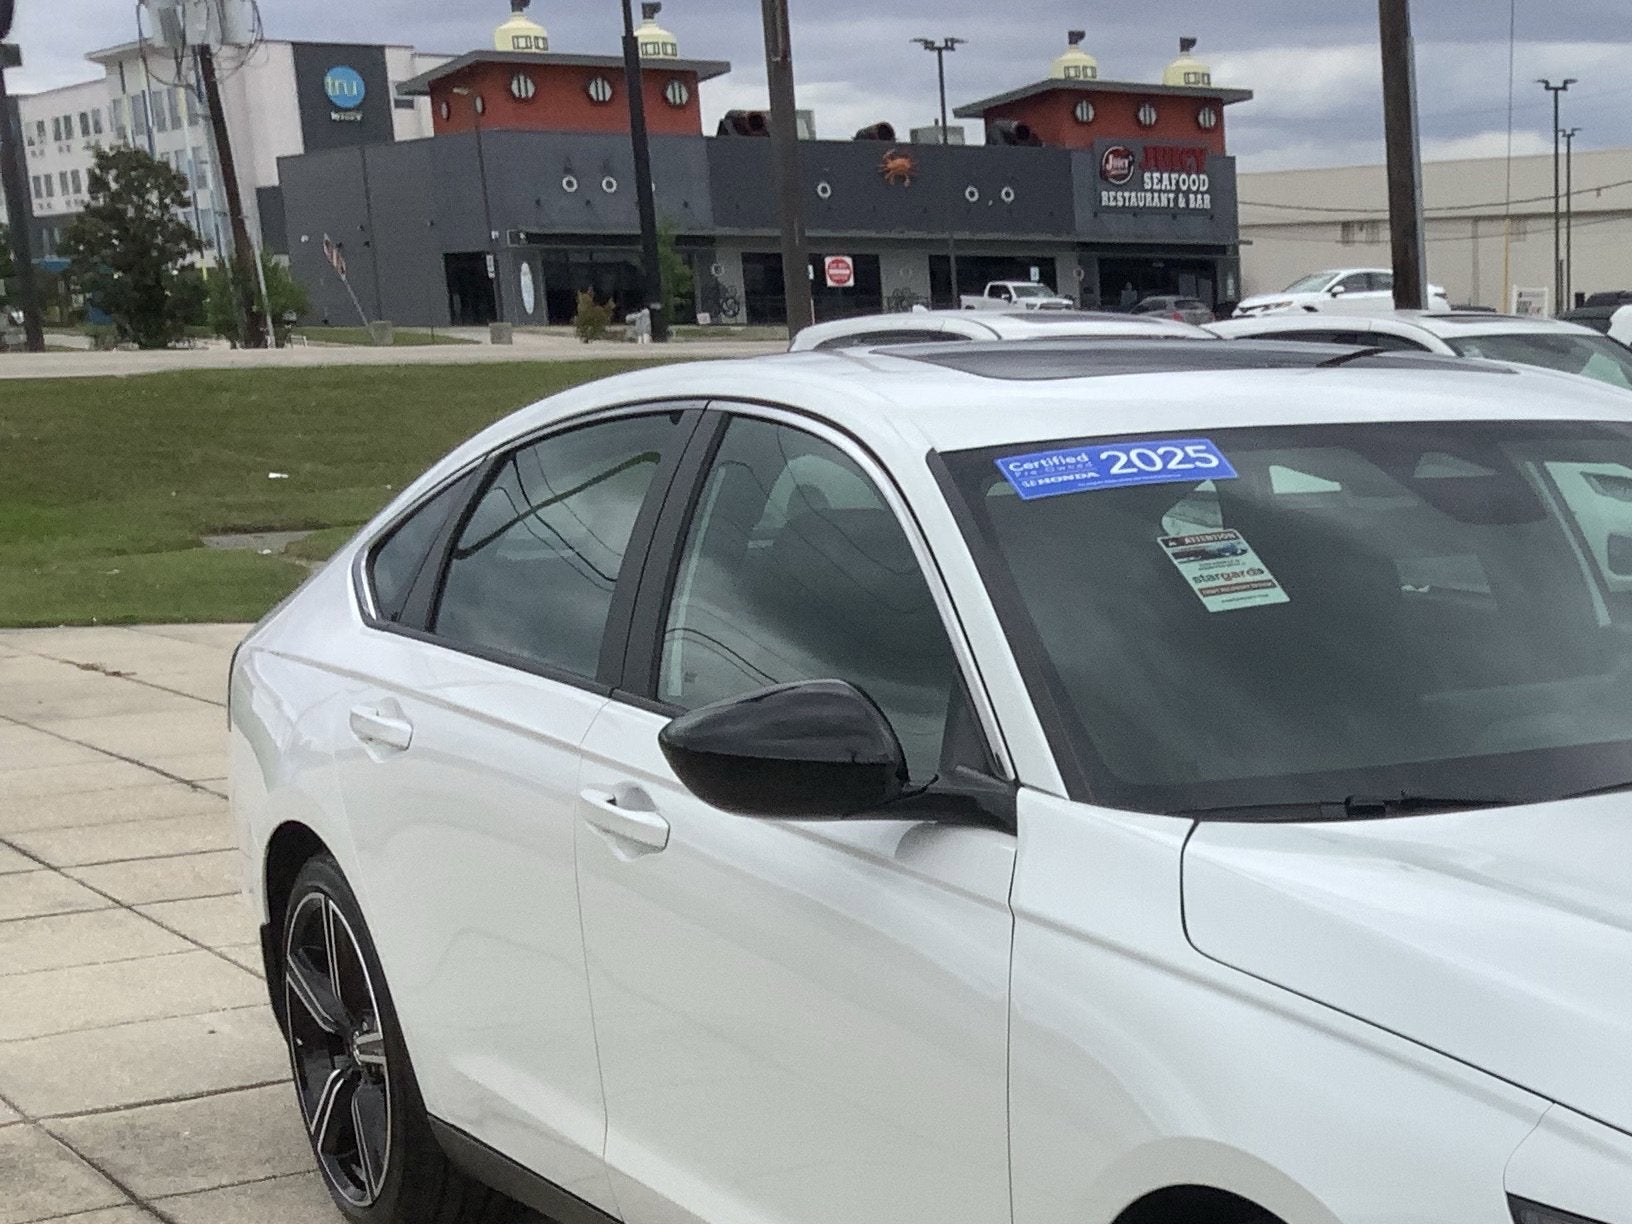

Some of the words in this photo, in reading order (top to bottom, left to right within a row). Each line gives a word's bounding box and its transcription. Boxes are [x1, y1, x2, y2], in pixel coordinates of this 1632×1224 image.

[325, 76, 358, 97] tru
[1143, 171, 1209, 192] SEAFOOD
[1101, 190, 1175, 208] RESTAURANT
[1178, 193, 1186, 208] &
[1189, 193, 1211, 209] BAR
[1008, 452, 1089, 472] Certified
[1100, 445, 1219, 475] 2025
[1038, 471, 1101, 486] HONDA
[1185, 532, 1236, 545] ATTENTION
